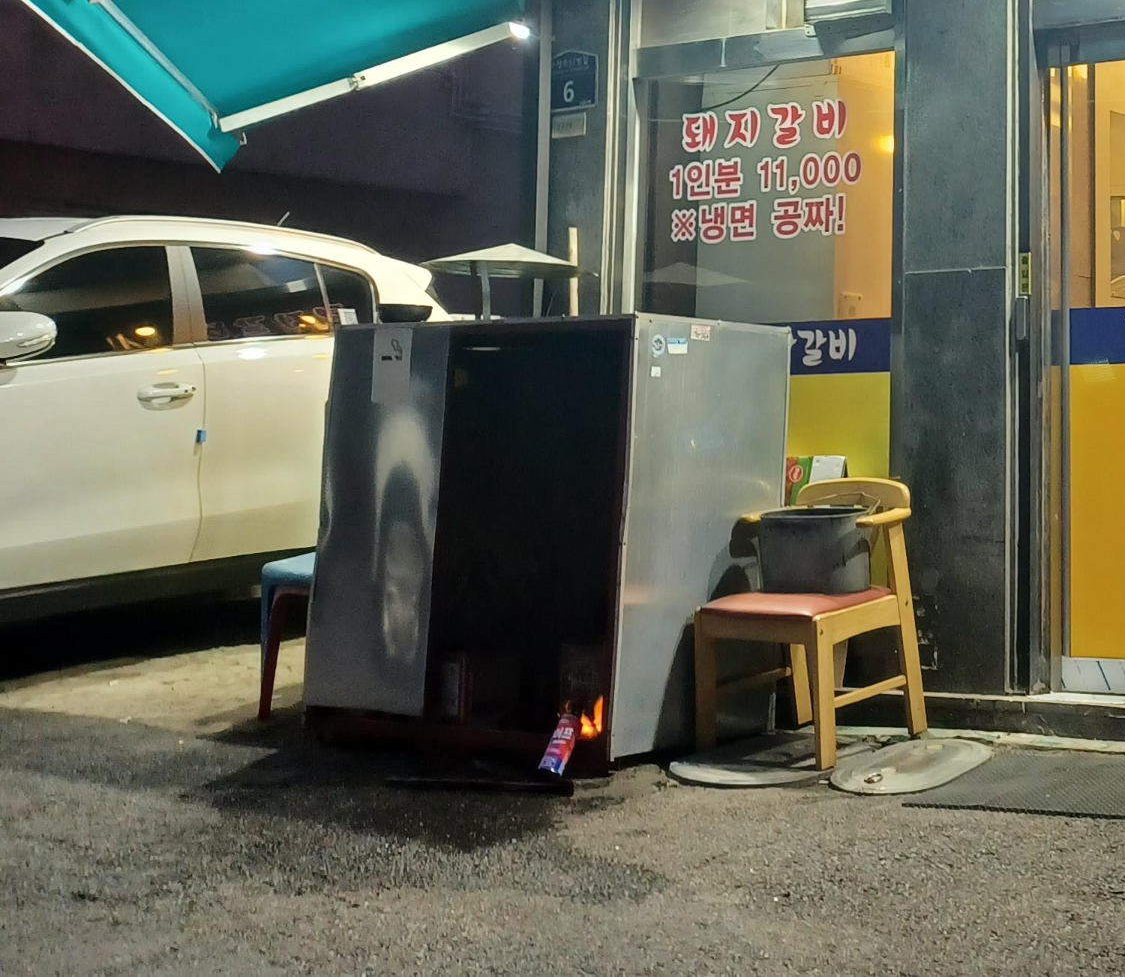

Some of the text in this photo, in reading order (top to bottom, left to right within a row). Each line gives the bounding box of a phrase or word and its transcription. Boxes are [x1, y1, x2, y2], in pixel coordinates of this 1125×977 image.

[563, 80, 575, 103] 6
[682, 99, 848, 151] 돼지갈비
[670, 152, 863, 199] 1인분 11,000
[770, 196, 847, 237] 공짜!
